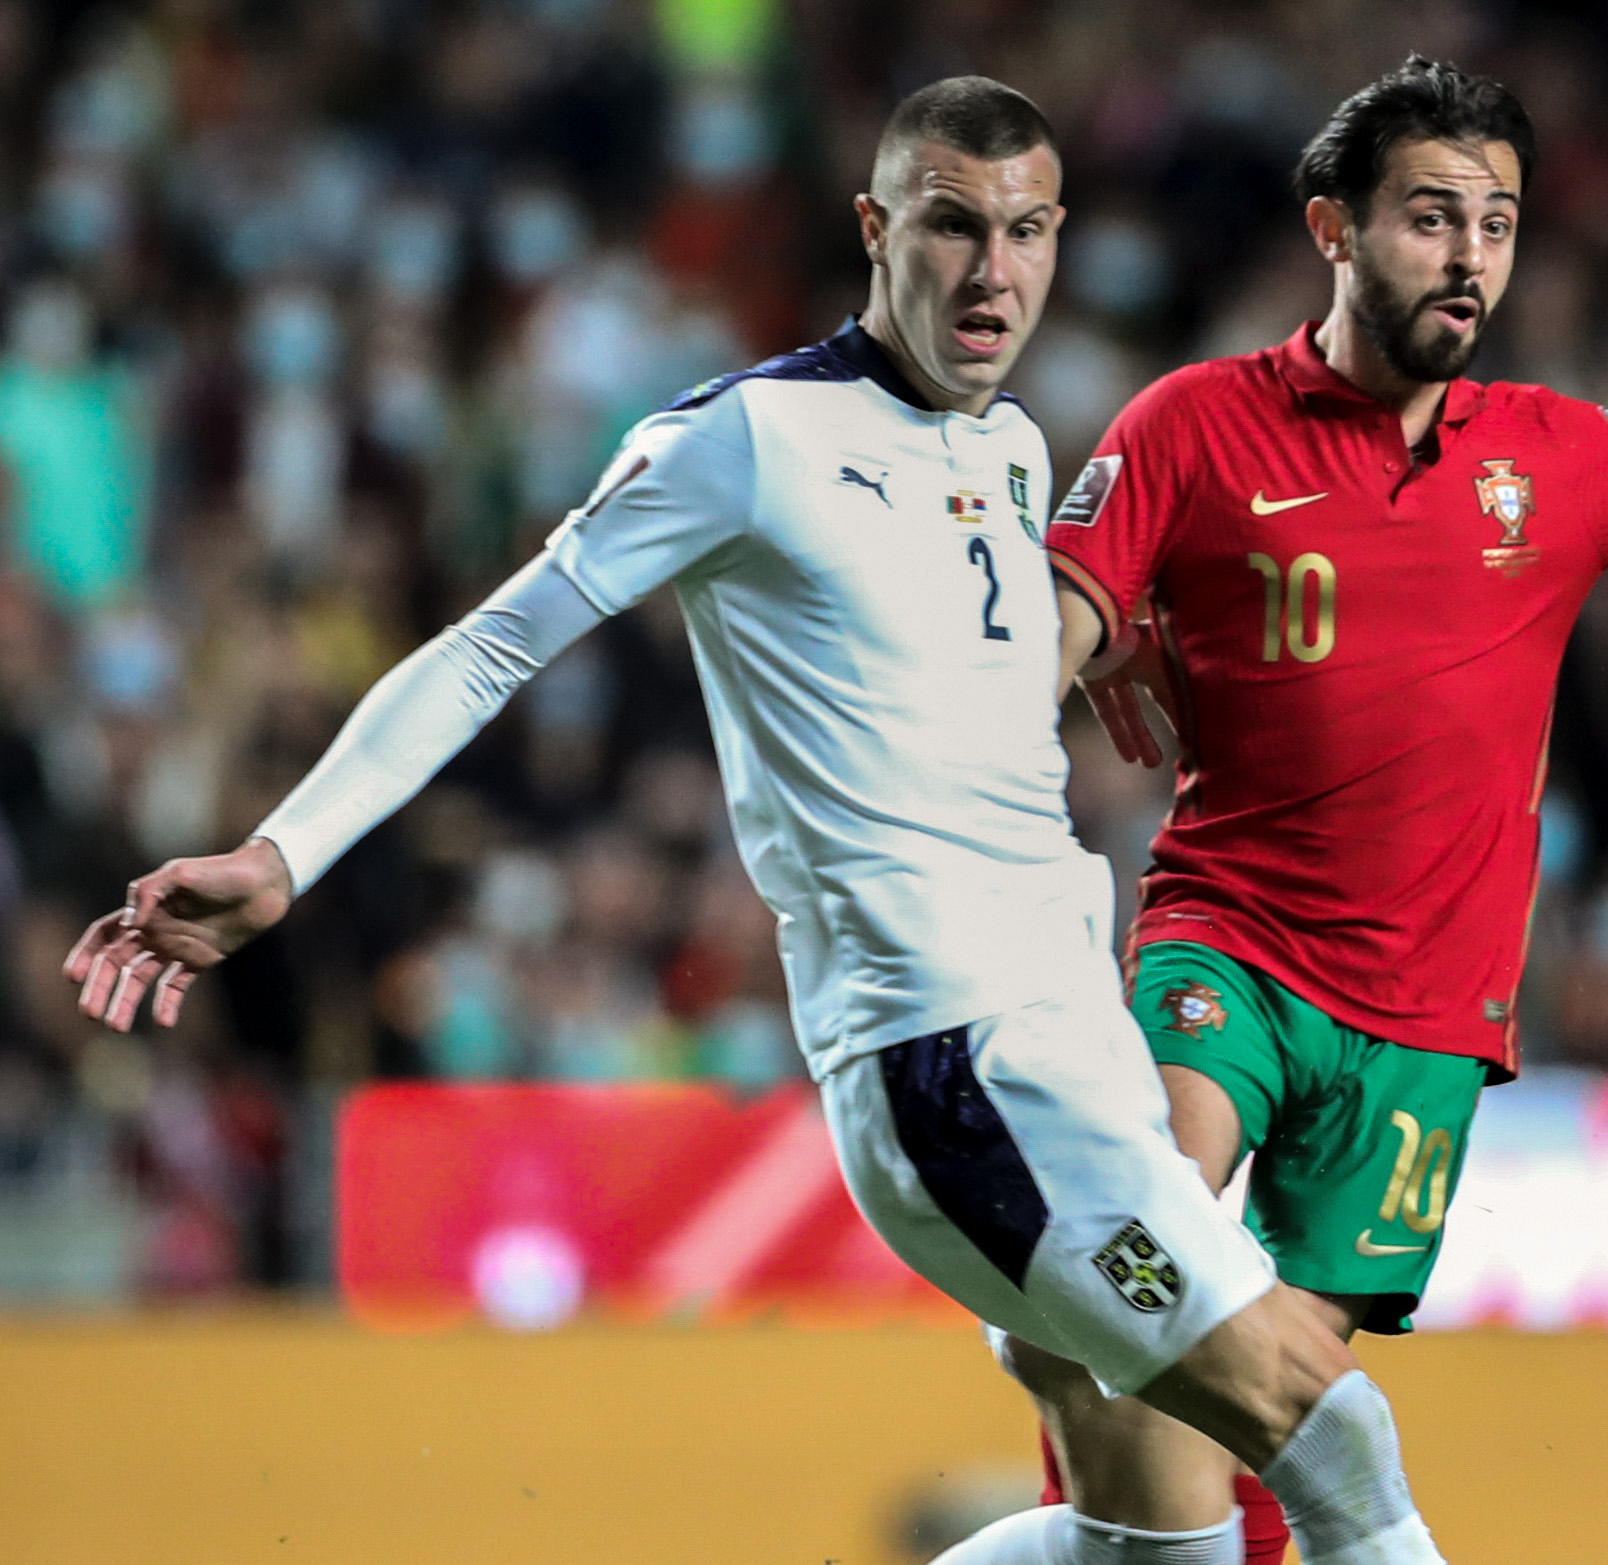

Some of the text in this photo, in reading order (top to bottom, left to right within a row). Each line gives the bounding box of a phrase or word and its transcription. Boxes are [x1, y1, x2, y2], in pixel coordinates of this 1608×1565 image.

[967, 536, 1012, 641] 2
[1247, 552, 1337, 662] 10
[1378, 1109, 1454, 1233] 10
